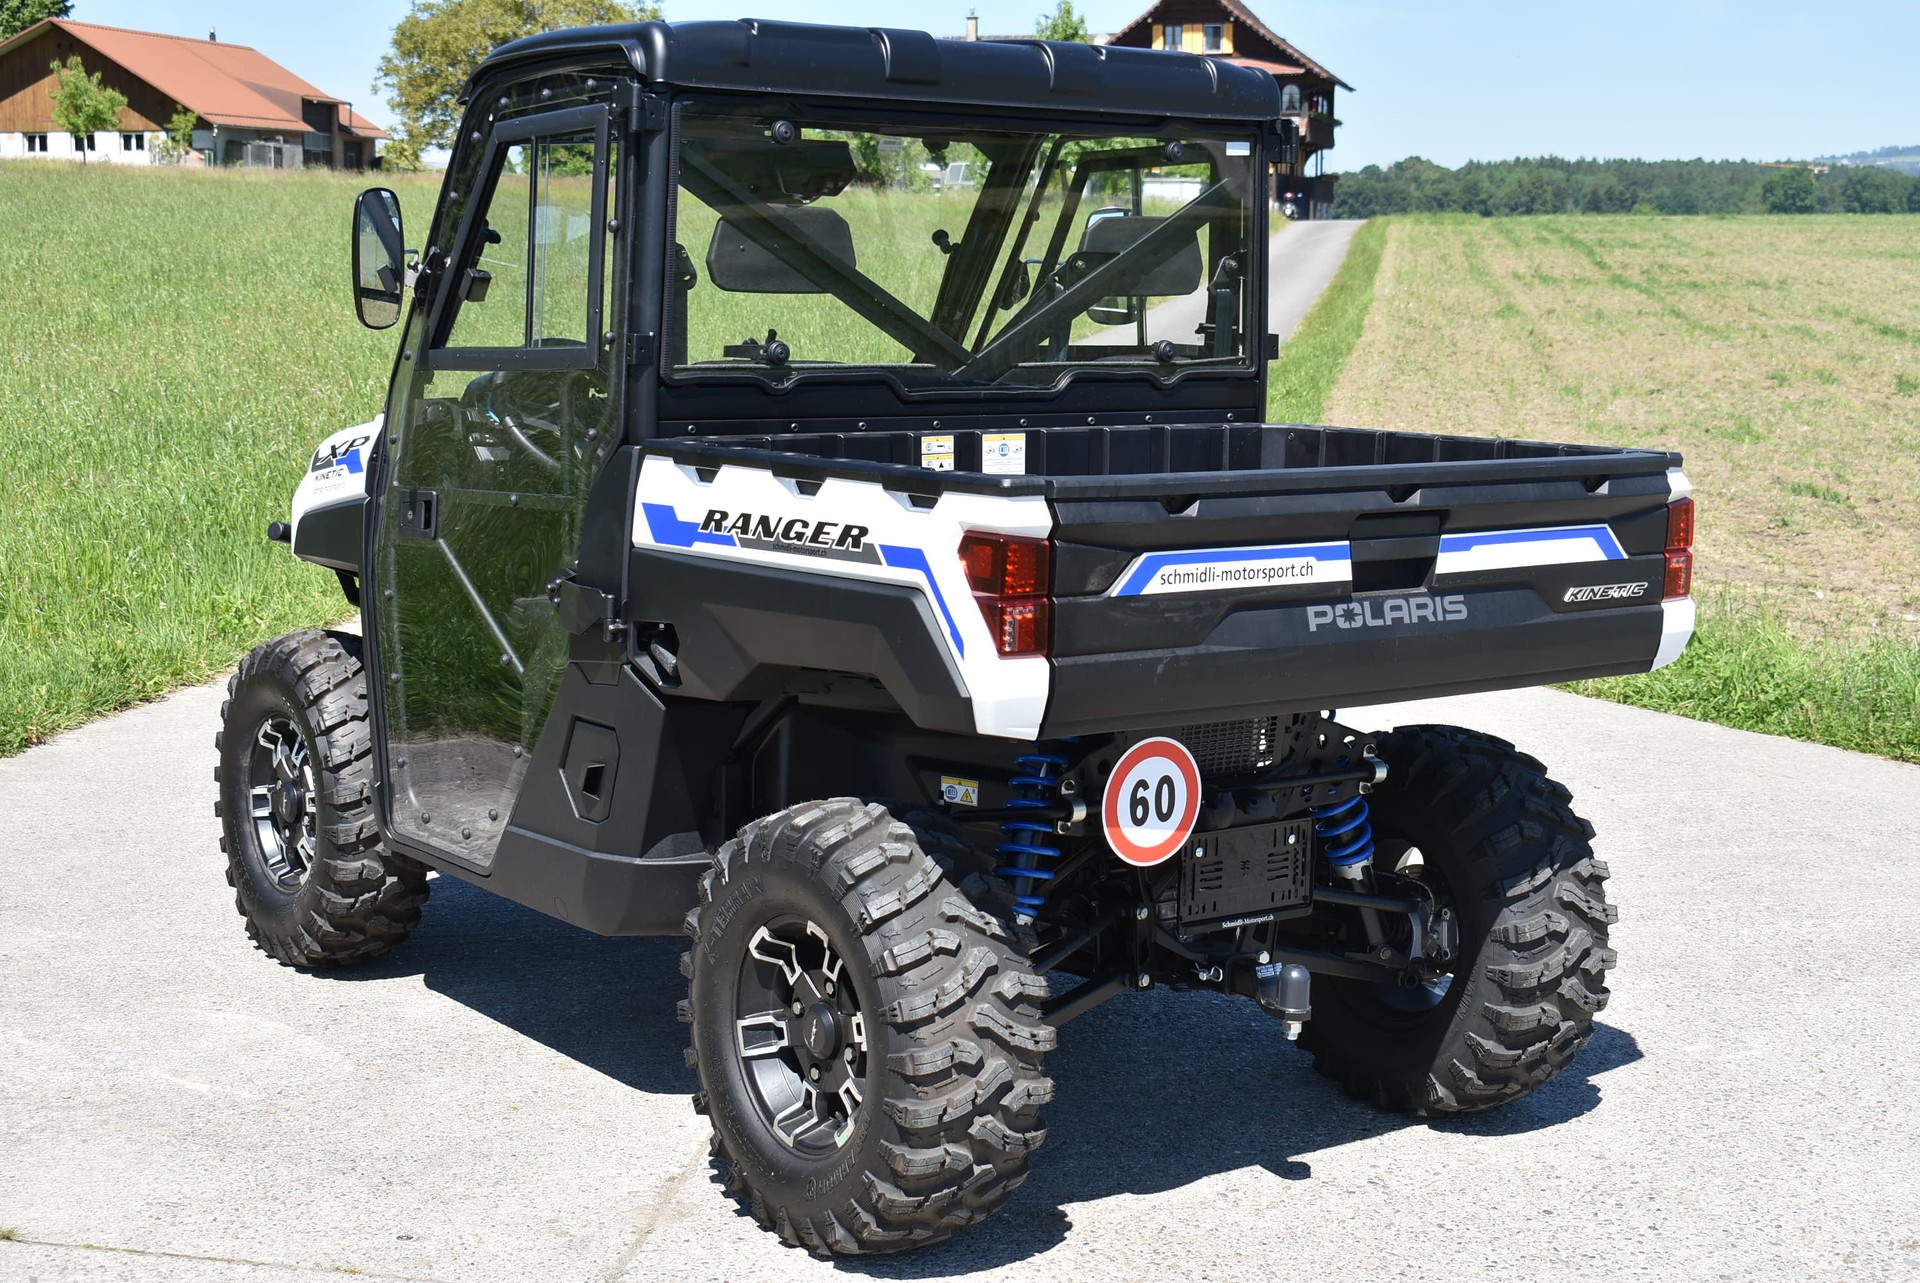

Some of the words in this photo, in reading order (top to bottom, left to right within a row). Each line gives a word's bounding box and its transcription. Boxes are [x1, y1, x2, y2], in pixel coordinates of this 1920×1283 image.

[314, 467, 345, 483] KINETIC
[700, 509, 869, 551] RANGER
[1160, 561, 1314, 586] schmidli-motorsport.ch
[1563, 582, 1648, 602] KINETIC
[1306, 595, 1468, 632] POLARIS
[1129, 774, 1176, 827] 60
